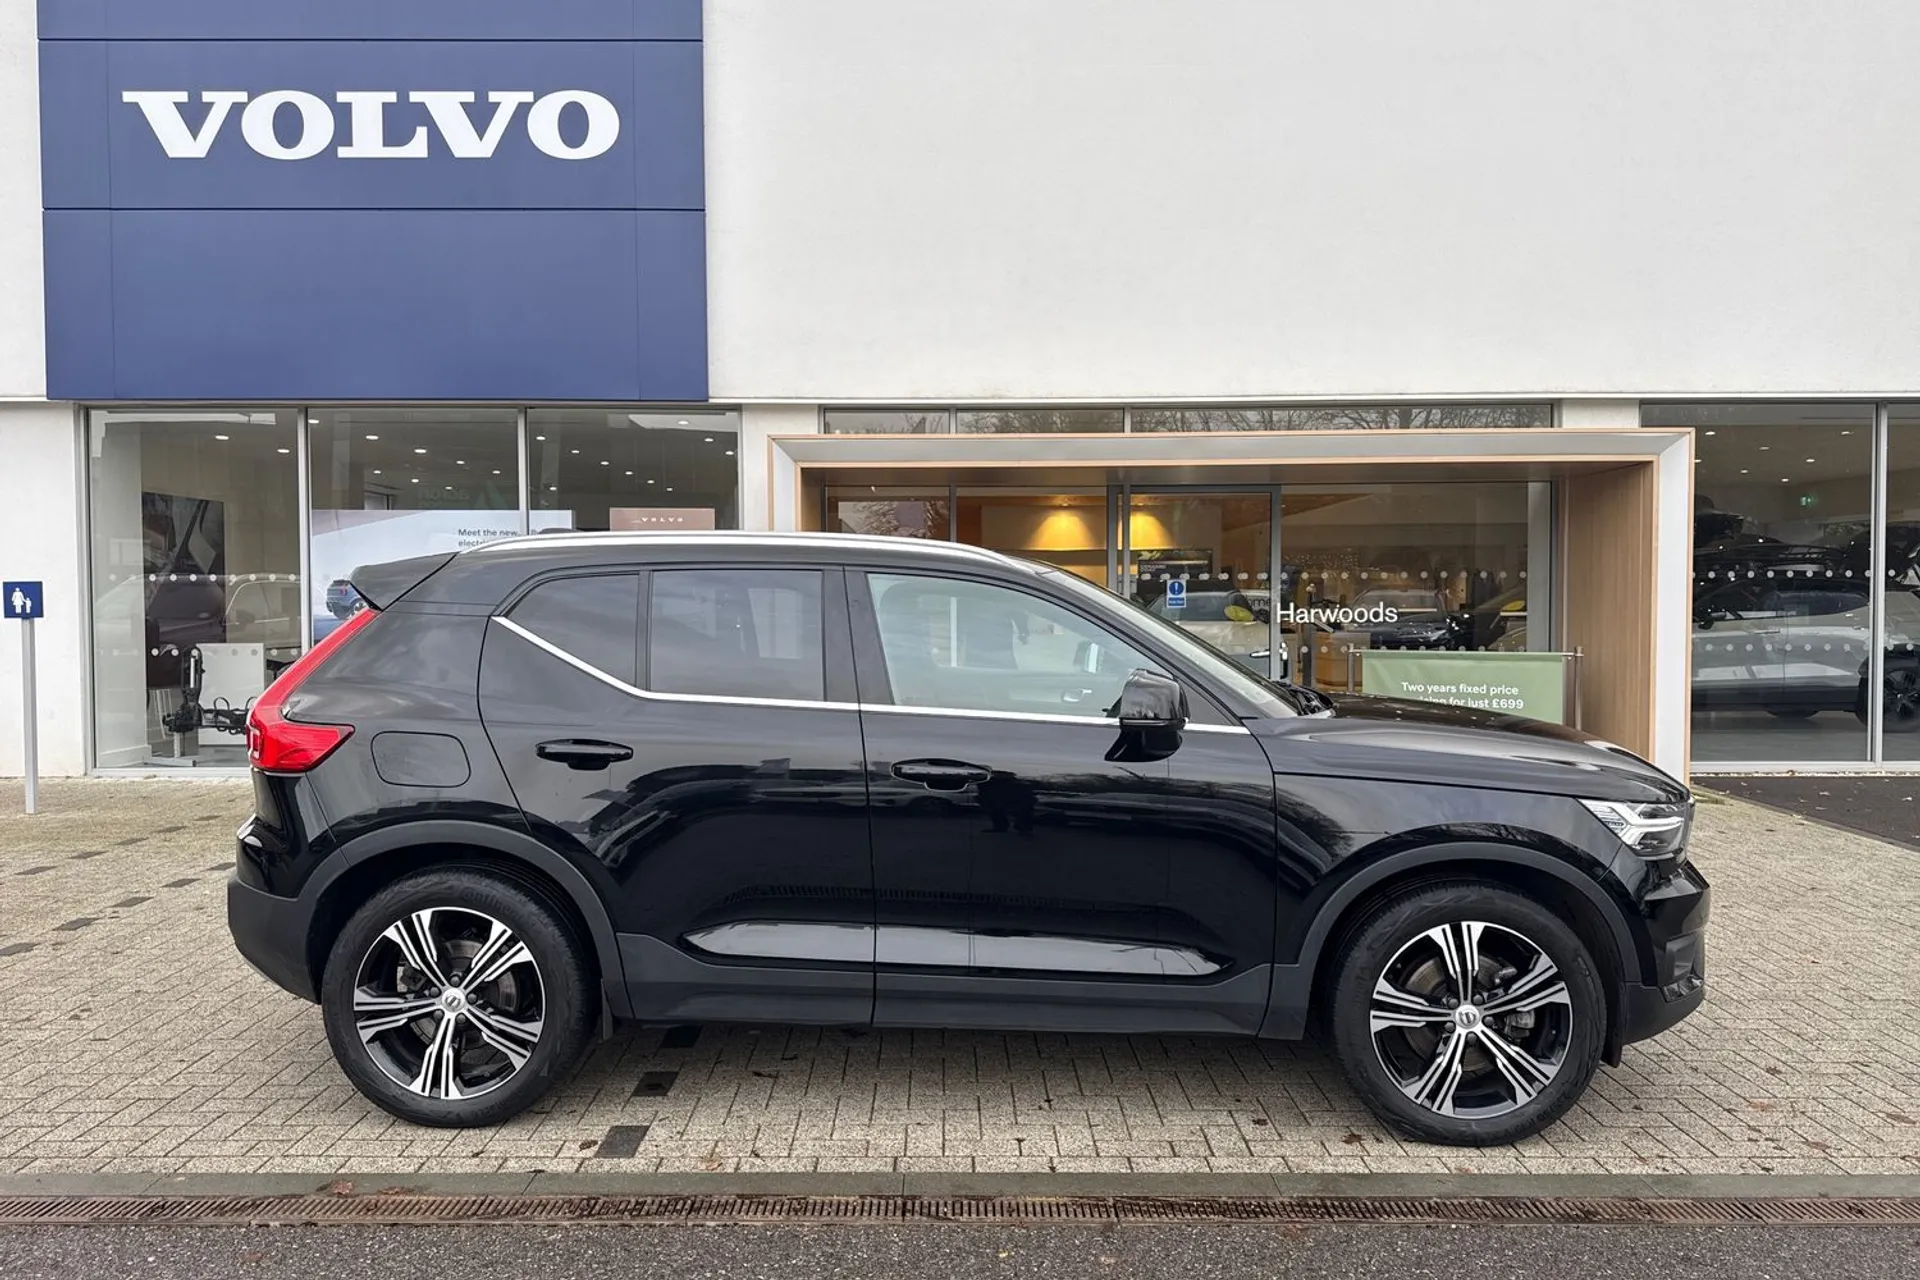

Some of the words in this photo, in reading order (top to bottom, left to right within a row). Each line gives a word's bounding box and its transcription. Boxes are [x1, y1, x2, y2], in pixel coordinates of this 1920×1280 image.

[122, 90, 620, 160] VOLVO
[458, 529, 480, 537] Meet
[483, 529, 497, 537] the
[1276, 602, 1398, 623] Harwoods
[1401, 682, 1424, 692] Two
[1427, 684, 1456, 694] years
[1459, 684, 1487, 694] fixed
[1490, 685, 1519, 696] price
[1492, 699, 1524, 709] £699
